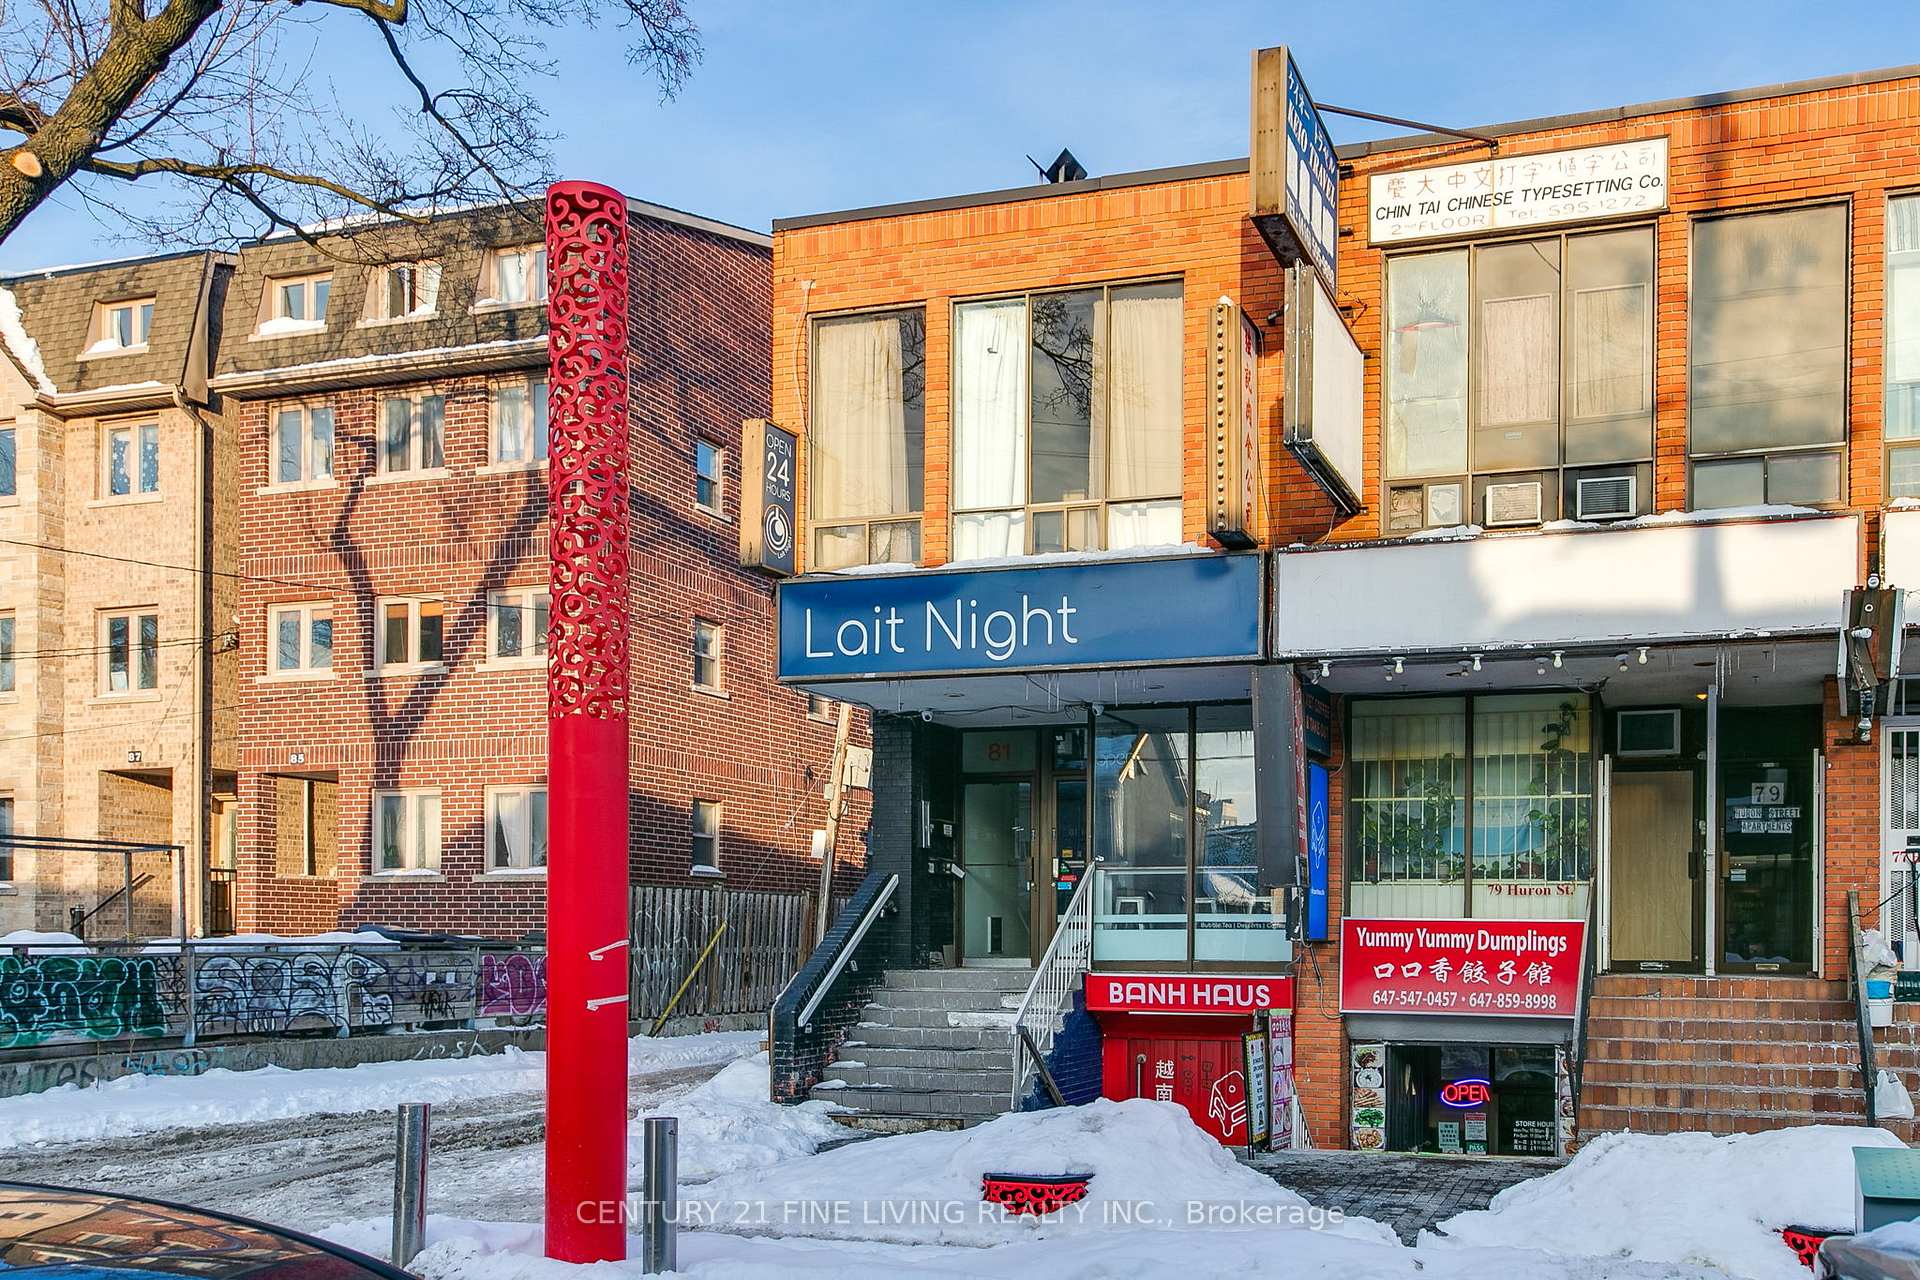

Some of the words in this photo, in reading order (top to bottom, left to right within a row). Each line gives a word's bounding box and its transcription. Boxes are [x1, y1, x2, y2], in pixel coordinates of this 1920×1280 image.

[1287, 99, 1308, 153] KEIO
[1309, 141, 1336, 209] TRAVEL
[1375, 200, 1411, 221] CHIN
[1418, 199, 1441, 215] TAI
[1447, 190, 1513, 212] CHINESE
[1521, 177, 1633, 203] TYPESETTING
[1638, 174, 1664, 188] Co.
[1418, 214, 1486, 233] FLOOR
[765, 432, 792, 458] OPEN
[766, 451, 790, 487] 24
[765, 481, 791, 502] HOURS
[806, 605, 905, 658] Lait
[926, 594, 1078, 661] Night
[128, 752, 141, 761] 87
[290, 753, 304, 763] 85
[1754, 785, 1780, 803] 79
[1735, 808, 1762, 819] HURON
[1768, 807, 1800, 818] STREET
[1741, 821, 1793, 833] APARTMENTS
[1487, 884, 1503, 896] 79
[1507, 884, 1552, 896] Huron
[1556, 884, 1575, 896] St.
[1356, 927, 1414, 953] Yummy
[1416, 928, 1475, 954] Yummy
[1477, 929, 1567, 957] Dumplings
[1373, 957, 1553, 986] 口口香餃子館
[1109, 982, 1185, 1005] BANH
[1193, 983, 1271, 1007] HAUS
[1373, 989, 1457, 1007] 647-547-0457
[1469, 991, 1556, 1010] 647-859-8998
[1155, 1059, 1174, 1102] 越南
[1444, 1084, 1491, 1103] OPEN
[1515, 1120, 1536, 1128] STORE
